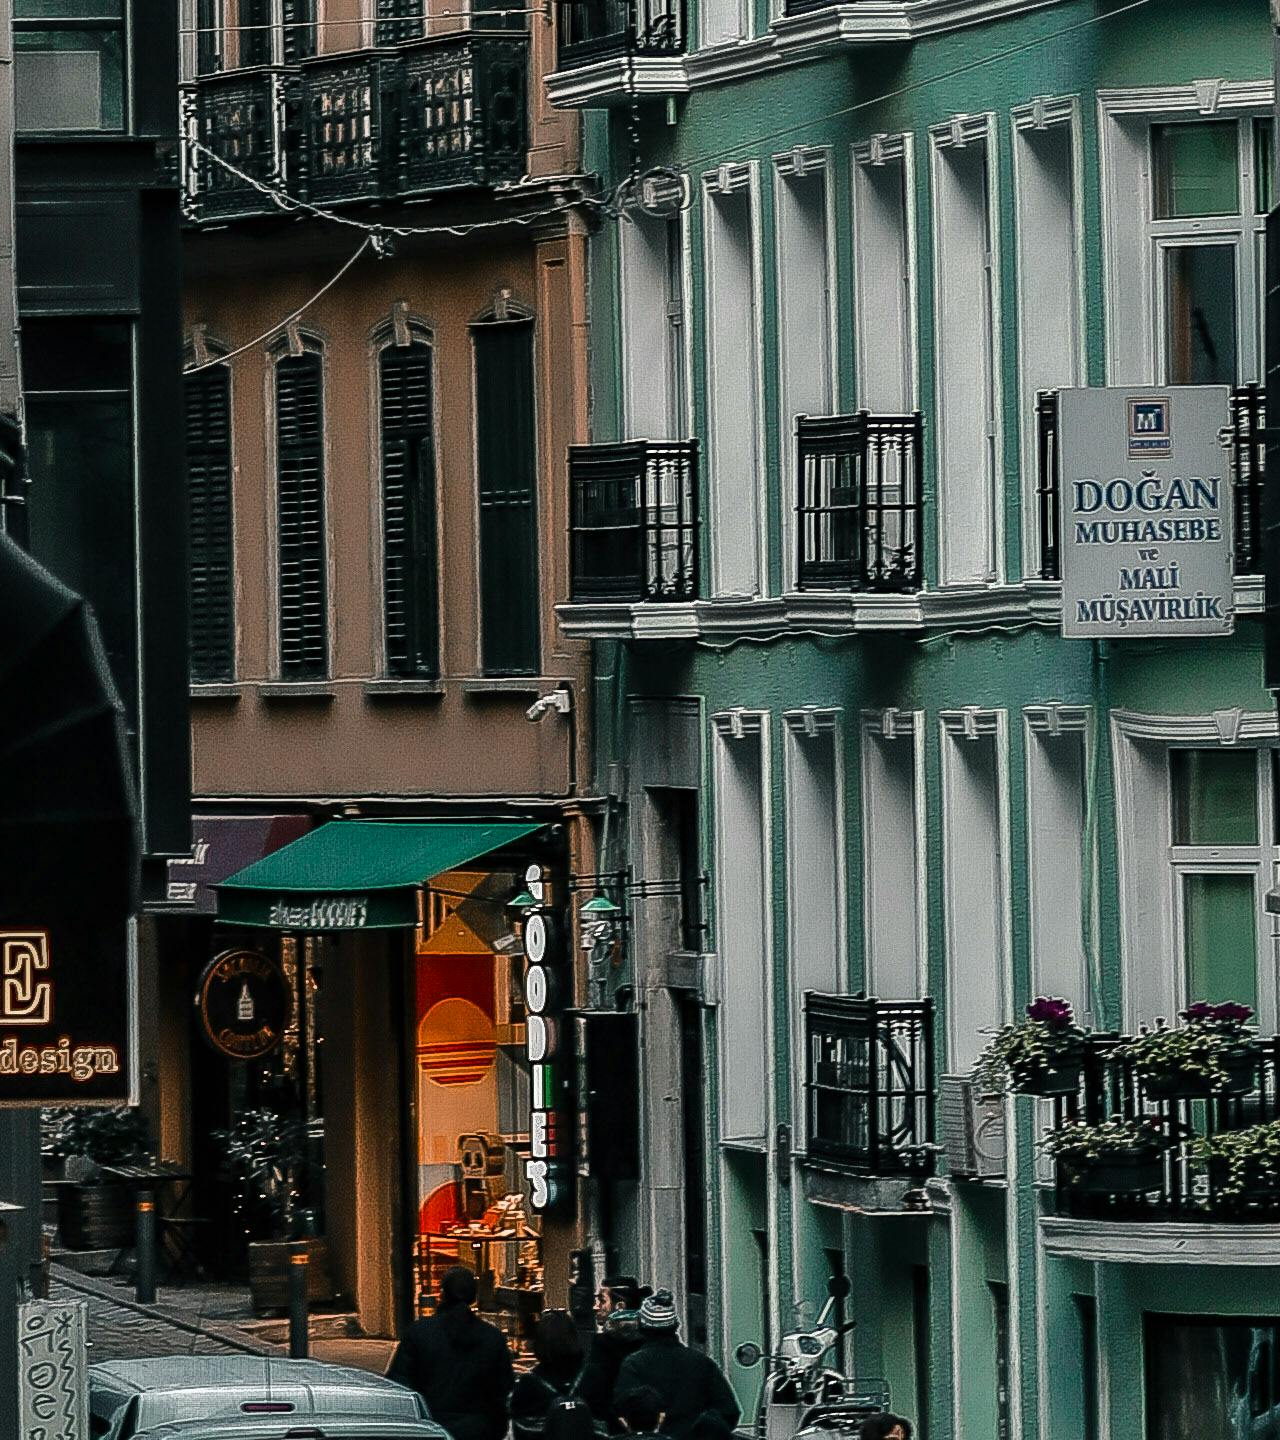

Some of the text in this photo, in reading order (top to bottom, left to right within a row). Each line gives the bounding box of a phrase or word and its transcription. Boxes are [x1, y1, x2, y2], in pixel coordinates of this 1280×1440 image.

[1072, 470, 1221, 514] DOĞAN
[1074, 519, 1222, 545] MUHASEBE
[1137, 548, 1159, 561] ve
[1119, 561, 1180, 590] MALİ
[1076, 592, 1222, 629] MÜŞAVİRLİK
